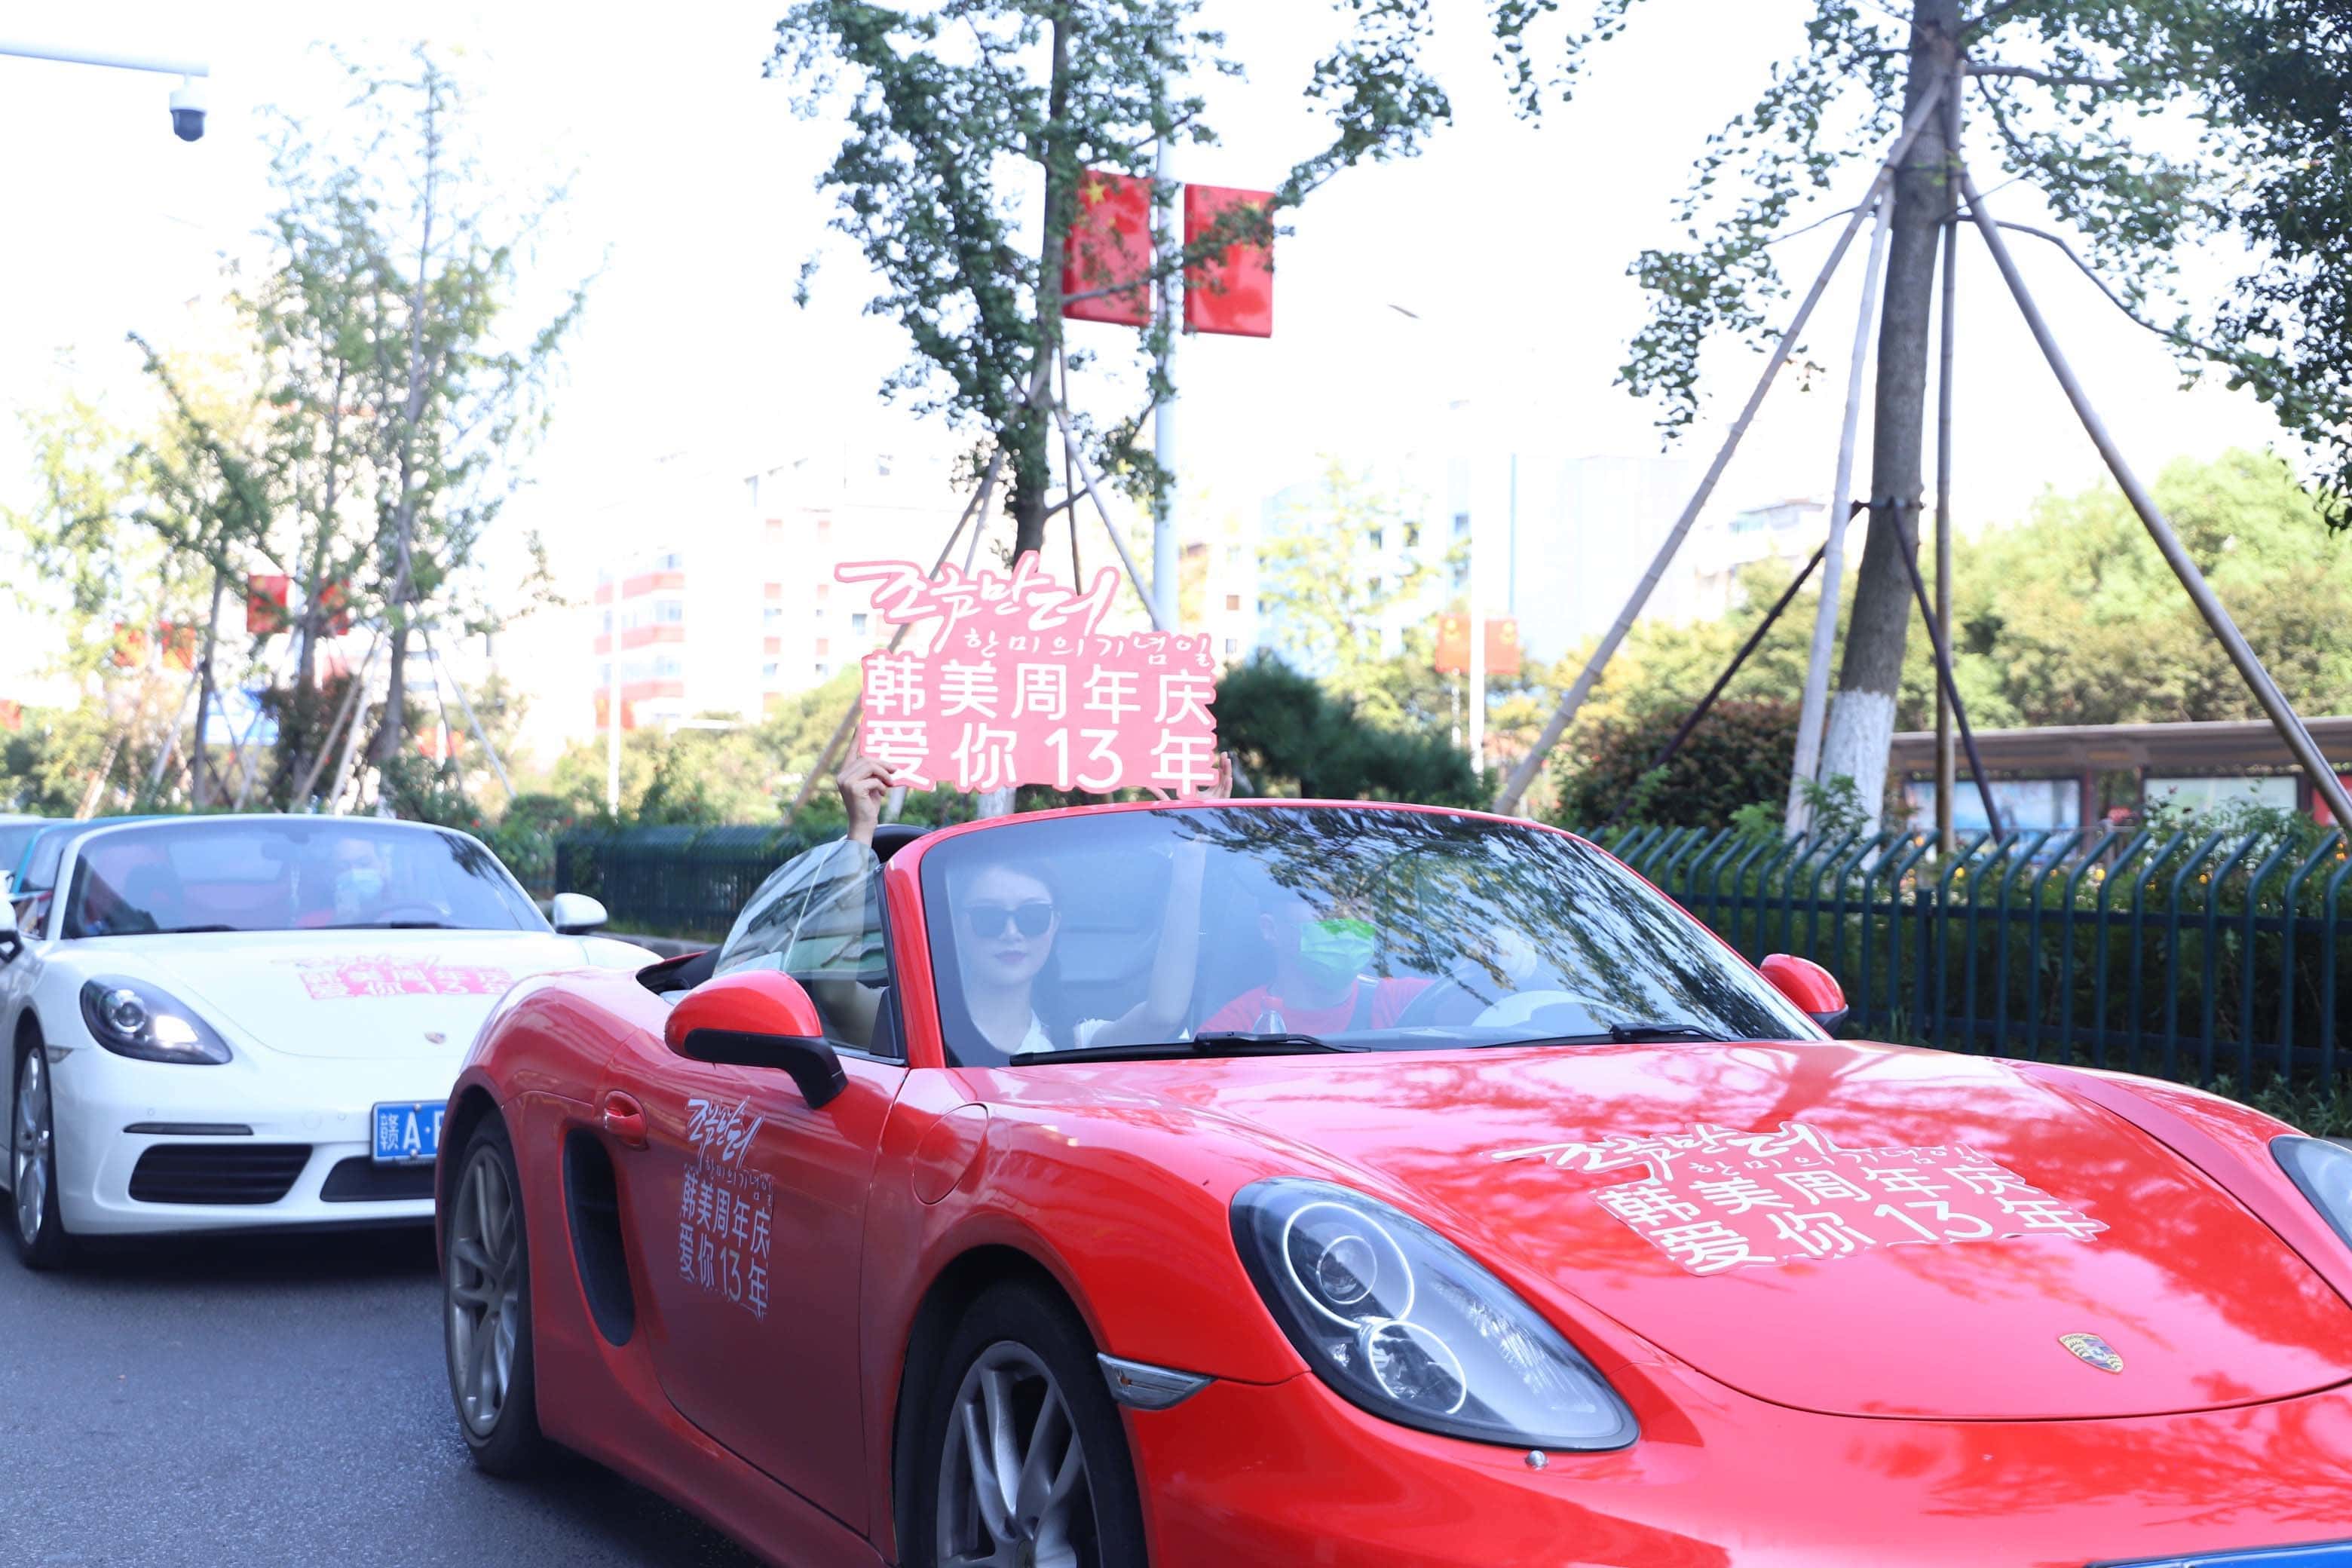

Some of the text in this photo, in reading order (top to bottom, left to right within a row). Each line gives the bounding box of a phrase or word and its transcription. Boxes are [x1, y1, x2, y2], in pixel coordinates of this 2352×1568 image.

[865, 654, 1211, 724] 韩美周年庆
[865, 720, 1215, 795] 爱你13年
[681, 1169, 770, 1258] 韩美周年庆
[1597, 1165, 2039, 1226] 韩美周年庆
[679, 1222, 767, 1319] 爱你13年
[1649, 1197, 2096, 1272] 爱你13年
